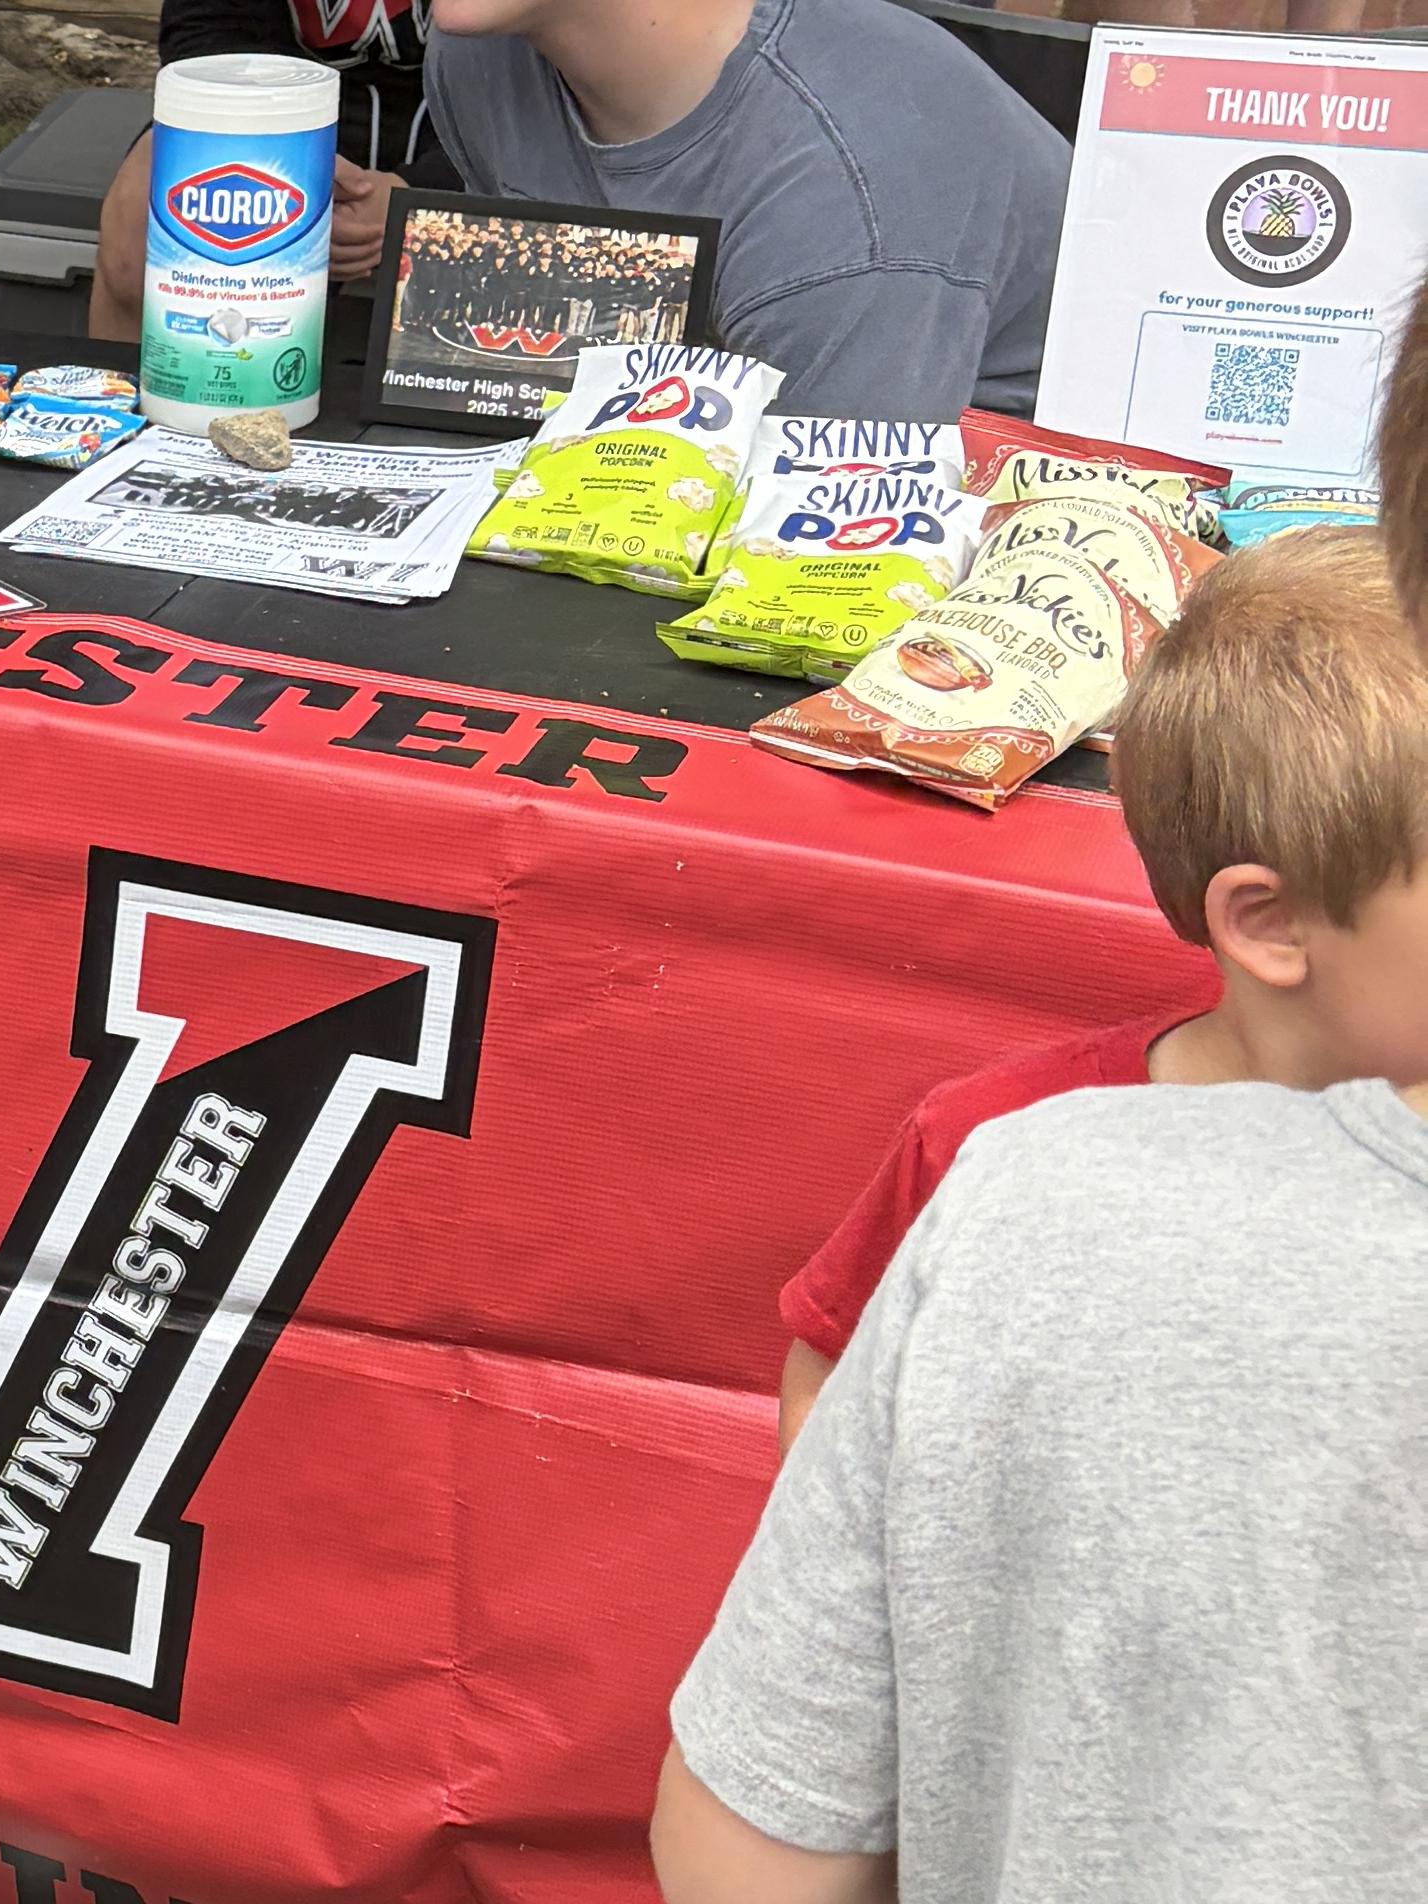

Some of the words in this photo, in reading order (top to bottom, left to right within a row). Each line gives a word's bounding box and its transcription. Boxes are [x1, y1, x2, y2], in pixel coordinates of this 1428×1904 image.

[1205, 87, 1311, 128] THANK
[1319, 95, 1392, 133] YOU!
[181, 185, 291, 225] CLOROX
[1228, 173, 1280, 213] PLAYA
[1288, 173, 1334, 220] BOWLS
[171, 270, 247, 290] Disinfecting
[174, 285, 205, 299] 99.9%
[1158, 290, 1183, 306] for
[1186, 296, 1222, 310] your
[1225, 300, 1302, 316] generous
[1304, 305, 1374, 321] support!
[213, 365, 232, 381] 75
[382, 369, 469, 396] inchester
[472, 378, 514, 400] High
[466, 399, 508, 416] 2025
[523, 406, 543, 420] 20
[306, 457, 367, 472] Open
[376, 463, 432, 473] Mats
[315, 449, 418, 465] Wrestling
[594, 442, 668, 461] ORIGINAL
[600, 456, 654, 468] POPCORN
[1012, 457, 1098, 501] Miss
[777, 512, 946, 551] POP
[986, 522, 1061, 562] Miss
[799, 562, 882, 574] ORIGINAL
[806, 571, 867, 580] POPCORN
[1005, 573, 1113, 660] Vickie's
[995, 650, 1052, 680] FLAVORED
[1025, 636, 1068, 680] BBQ
